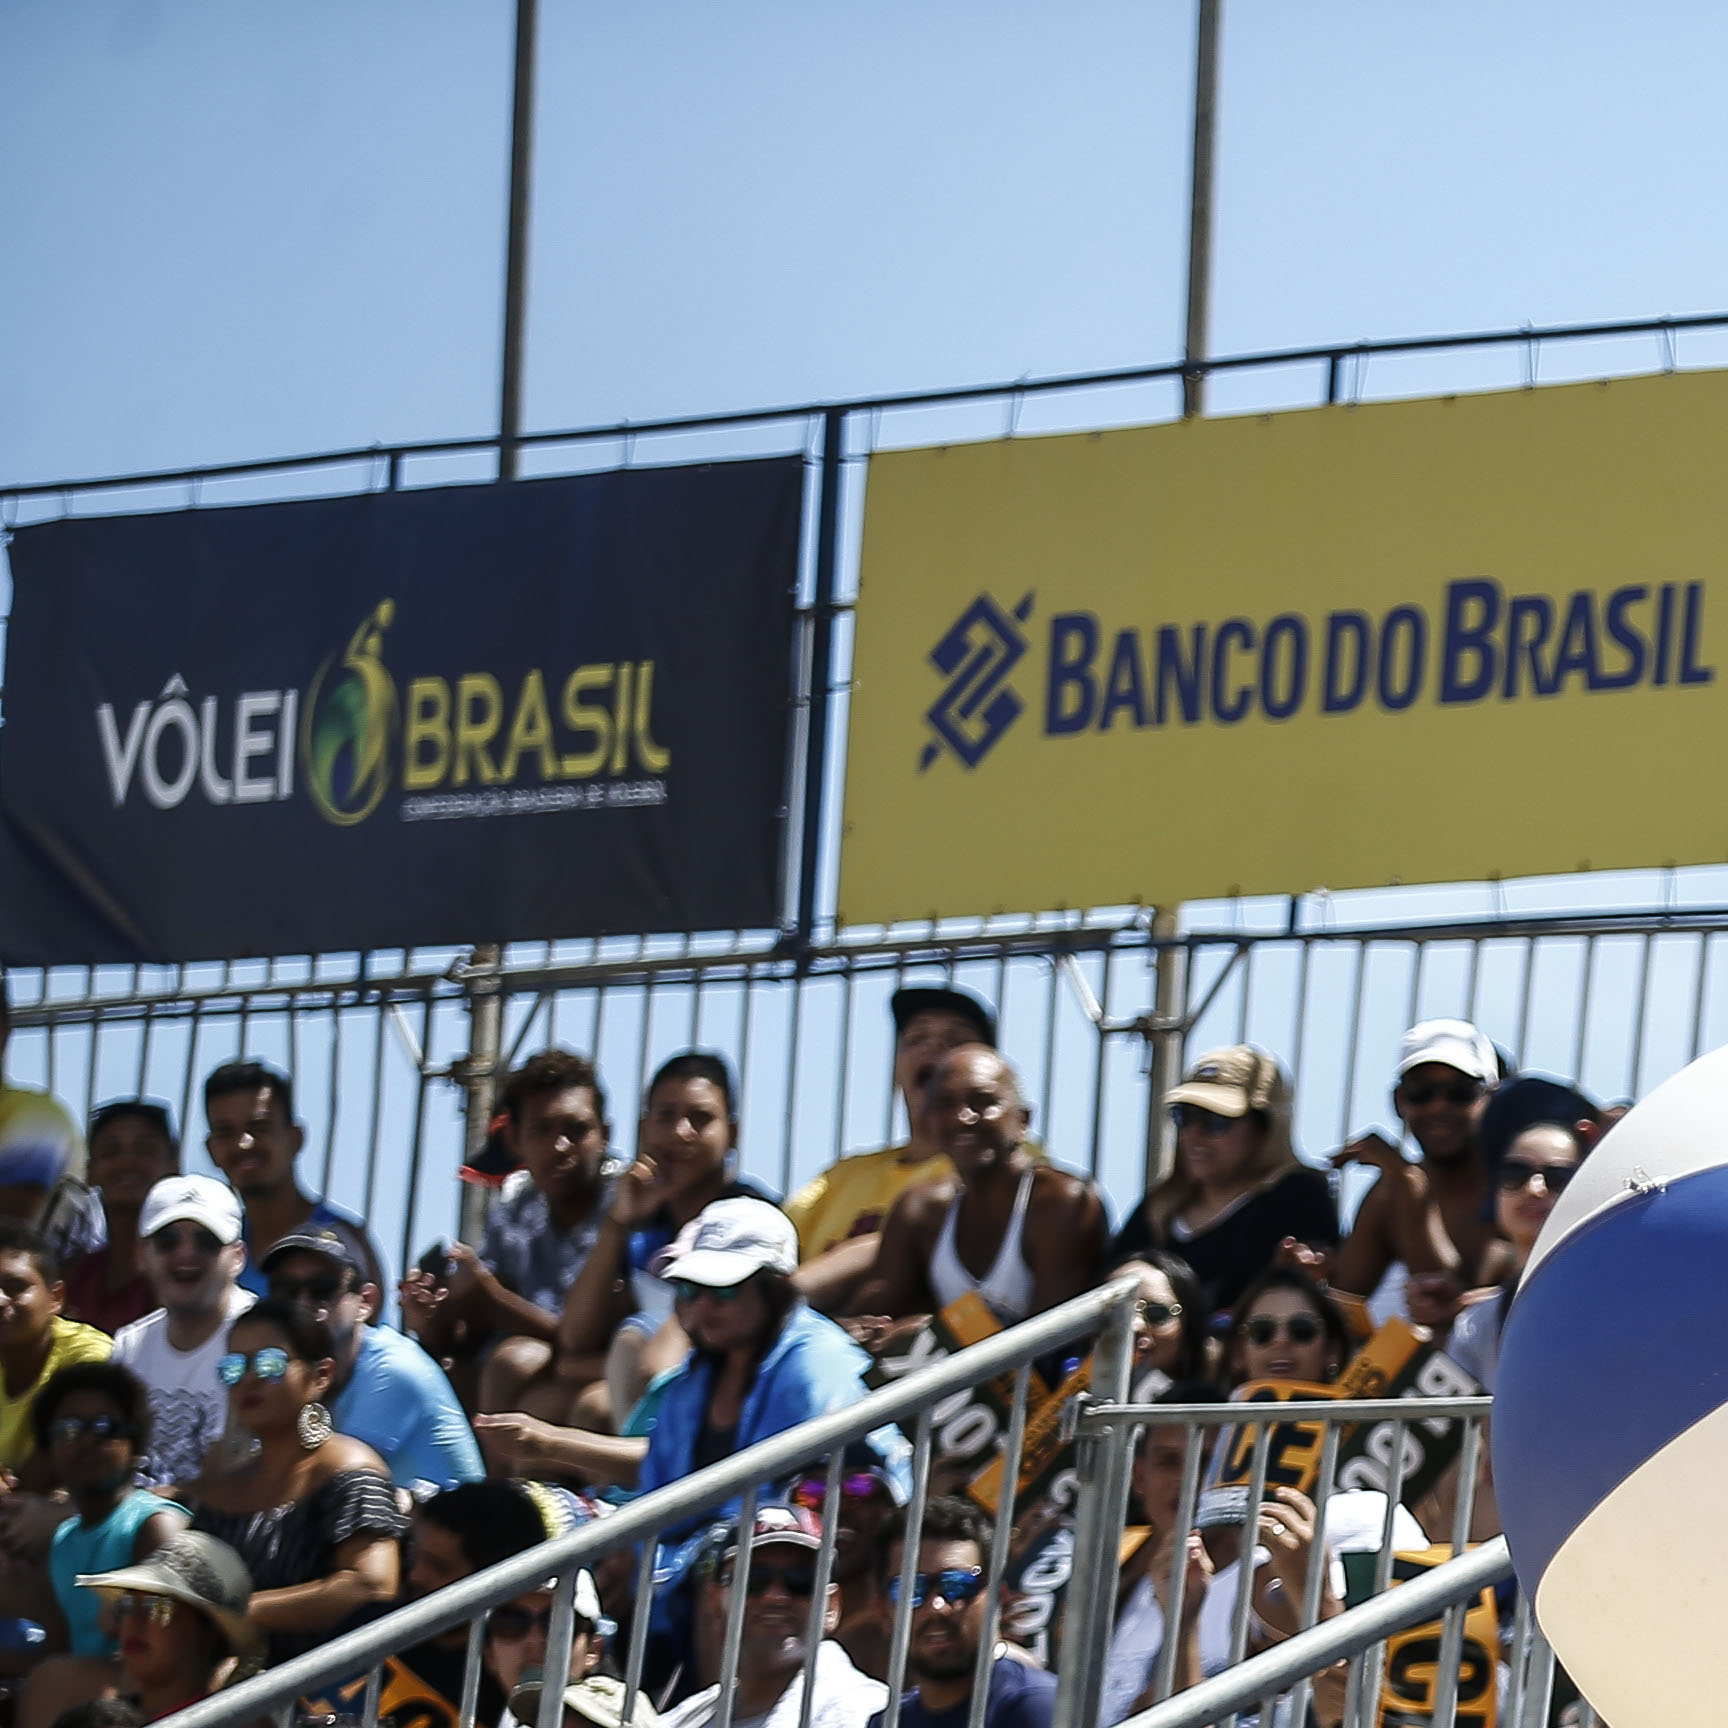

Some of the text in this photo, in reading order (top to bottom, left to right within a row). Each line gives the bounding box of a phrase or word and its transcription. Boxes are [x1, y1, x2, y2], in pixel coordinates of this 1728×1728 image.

[402, 659, 671, 792] BRASIL
[1044, 577, 1716, 738] BANCO DO BRASIL
[95, 672, 298, 810] VÔLEI
